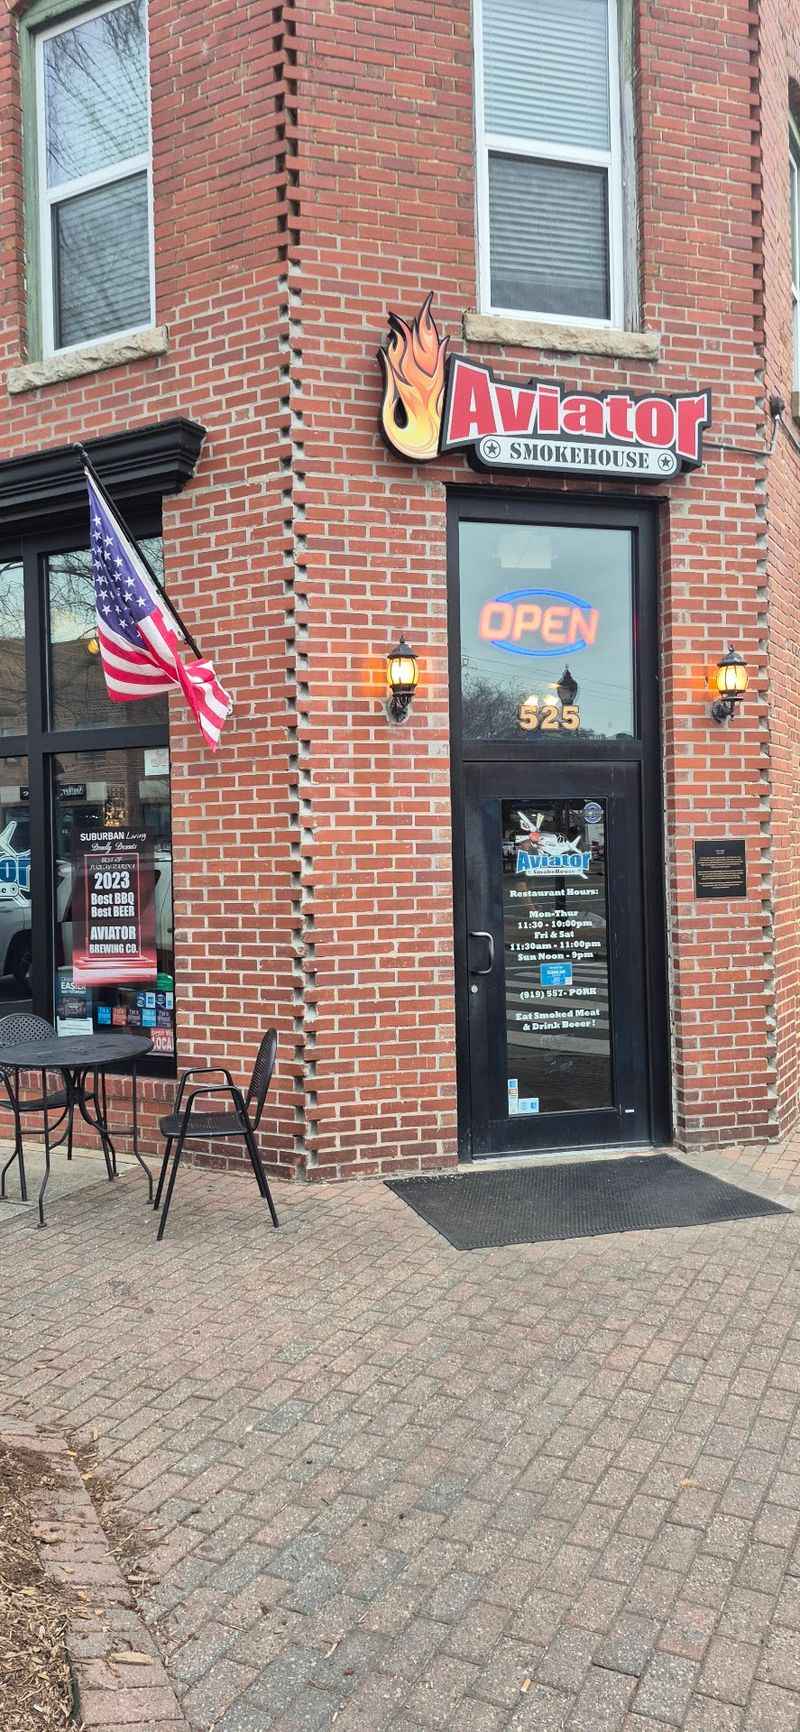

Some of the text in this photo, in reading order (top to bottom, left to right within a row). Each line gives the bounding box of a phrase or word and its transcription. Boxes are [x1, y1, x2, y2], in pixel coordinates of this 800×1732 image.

[446, 360, 708, 460] Aviator
[509, 441, 651, 470] SMOKEHOUSE
[479, 601, 599, 645] OPEN
[518, 703, 581, 732] 525
[80, 832, 125, 841] SUBURBAN
[516, 849, 592, 874] Aviator
[94, 871, 130, 890] 2023
[90, 892, 135, 905] Best BBQ
[510, 888, 599, 898] Restaurant Hours:
[91, 905, 135, 917] Best BEER
[529, 909, 579, 919] Mon-Thur
[518, 921, 544, 929] 11:30
[551, 919, 593, 929] 10:00pm
[90, 925, 136, 940] AVIATOR
[534, 931, 549, 940] Fri
[559, 930, 575, 938] Sat
[89, 943, 139, 954] BREWING CO.
[510, 942, 552, 951] 11:30am
[560, 940, 601, 950] 11:00pm
[517, 953, 537, 961] Sun
[538, 952, 565, 960] Noon
[571, 951, 594, 960] 9pm
[519, 990, 545, 999] (919)
[569, 987, 597, 996] PORK
[515, 1008, 600, 1021] Eat Smoked Meat
[522, 1023, 531, 1031] &
[531, 1021, 560, 1031] Drink
